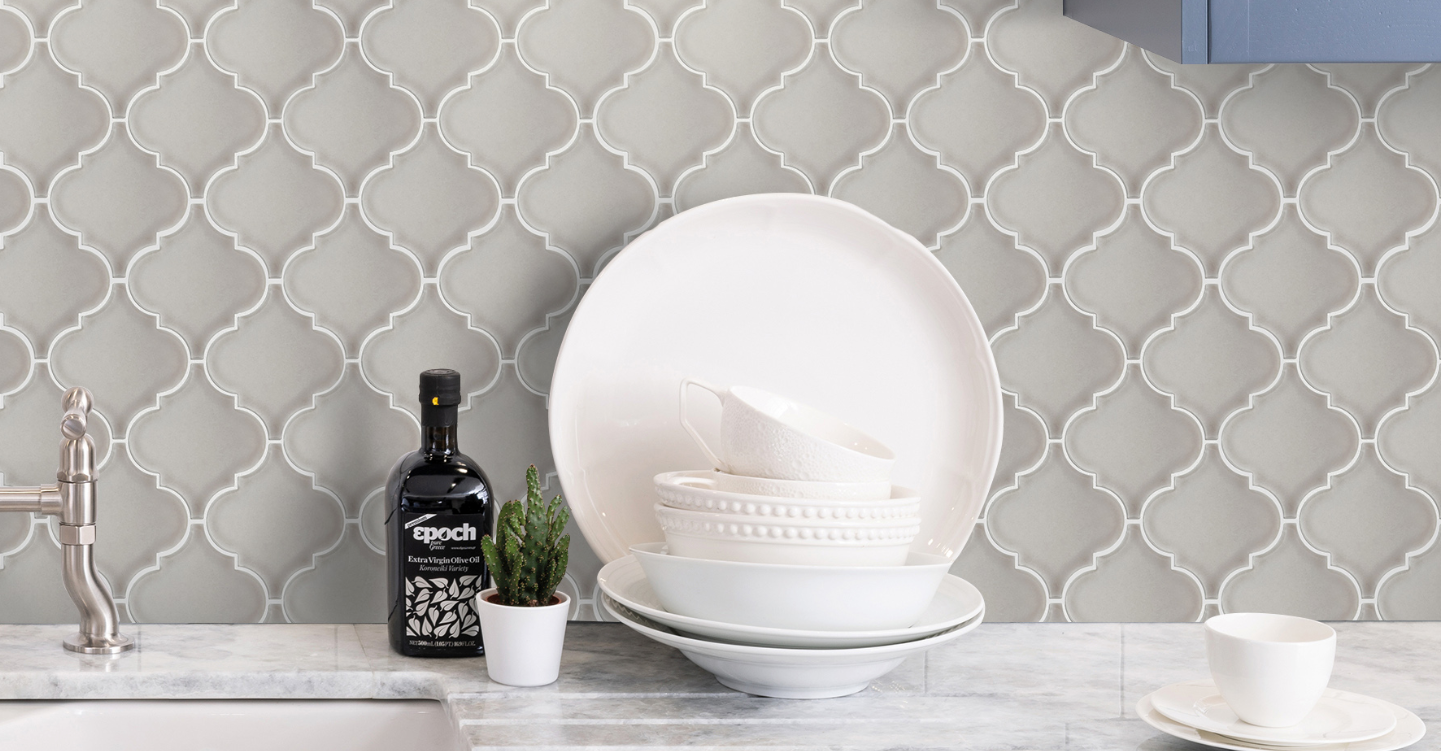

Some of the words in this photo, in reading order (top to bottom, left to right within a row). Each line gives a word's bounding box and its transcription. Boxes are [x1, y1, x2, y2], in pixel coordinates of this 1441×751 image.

[408, 555, 428, 563] Extra
[428, 556, 450, 565] Virgin
[448, 564, 469, 572] Variety
